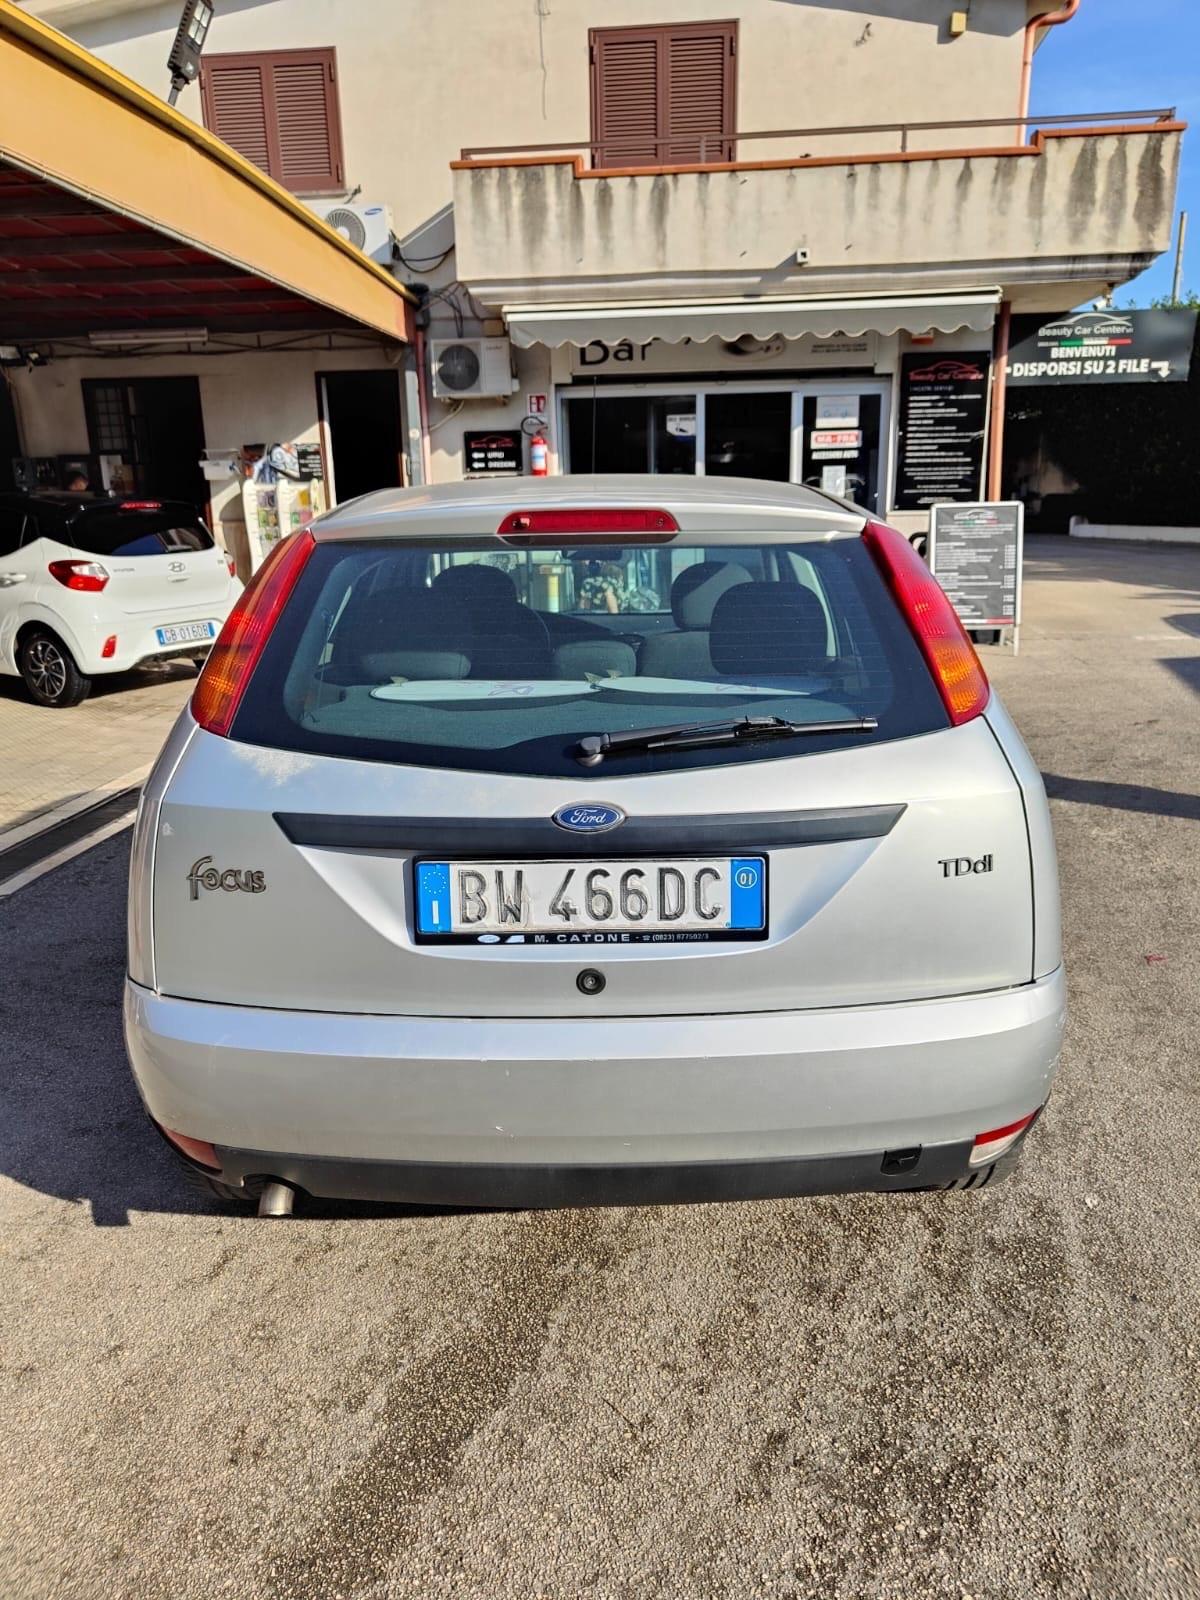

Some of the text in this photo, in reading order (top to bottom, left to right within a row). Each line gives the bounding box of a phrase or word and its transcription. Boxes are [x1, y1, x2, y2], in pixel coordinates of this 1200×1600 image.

[1038, 326, 1073, 338] Beauty
[1074, 325, 1091, 335] Car
[1093, 324, 1126, 334] Center
[1050, 345, 1117, 359] BENVENUTI
[1012, 358, 1151, 377] DISPORSI SU 2 FILE
[570, 808, 608, 824] Ford
[458, 868, 528, 926] BW
[534, 934, 549, 943] M.
[556, 933, 631, 943] CATONE
